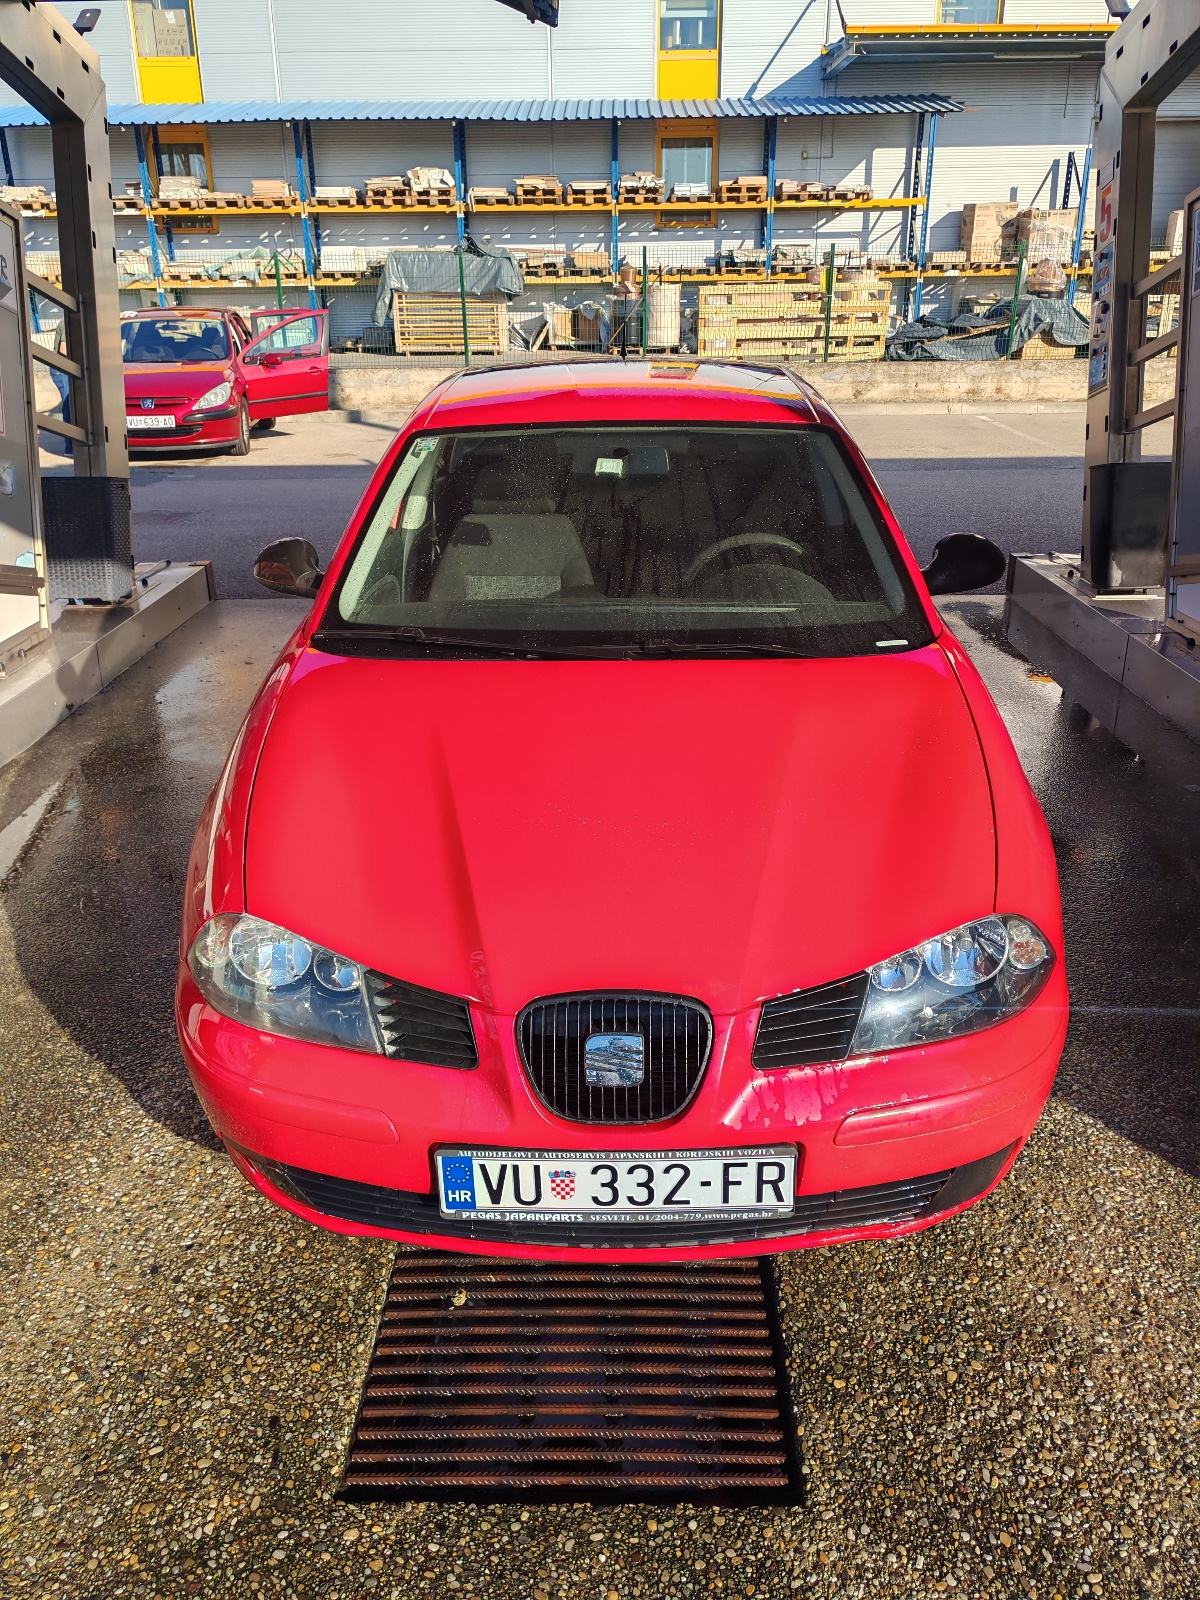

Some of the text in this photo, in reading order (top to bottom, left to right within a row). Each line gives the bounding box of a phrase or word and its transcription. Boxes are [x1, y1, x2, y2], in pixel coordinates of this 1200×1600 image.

[1100, 185, 1112, 242] 5
[457, 1150, 532, 1158] AUTODIJELOVI
[542, 1151, 606, 1159] AUTOSERVIS
[609, 1151, 665, 1159] JAPANSKIH
[676, 1150, 734, 1158] KOREJSKIH
[737, 1148, 775, 1156] VOZILA
[479, 1161, 785, 1207] VU 332-FR
[447, 1189, 472, 1202] HR
[461, 1211, 502, 1220] PEGAS
[505, 1212, 584, 1222] JAPANPARTS
